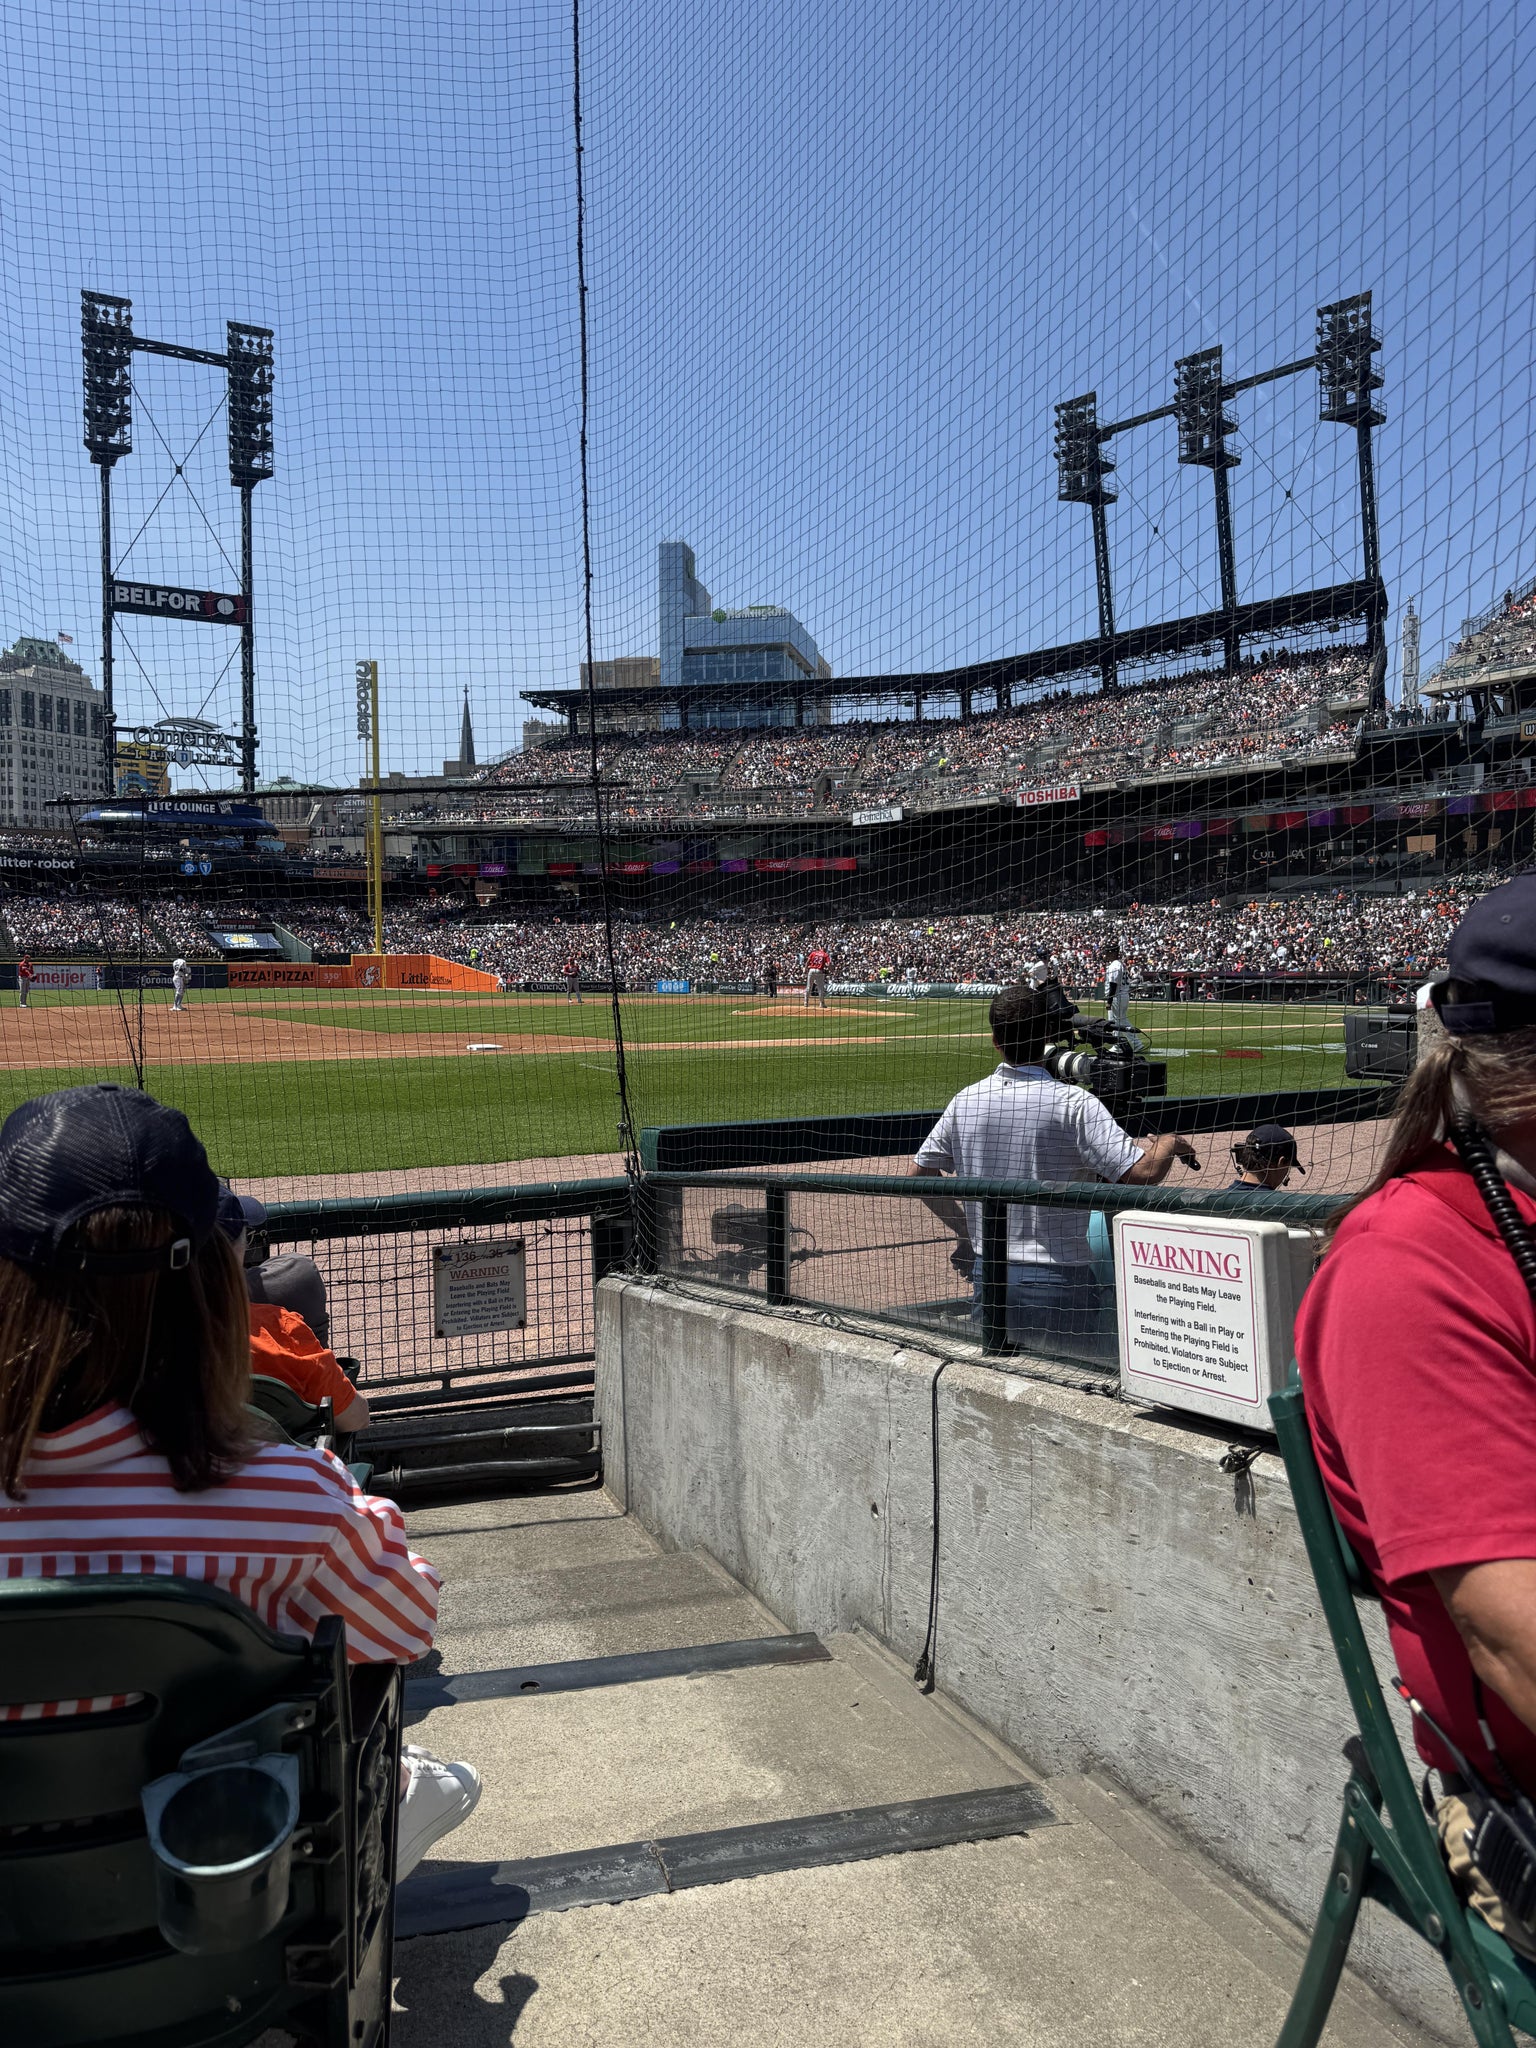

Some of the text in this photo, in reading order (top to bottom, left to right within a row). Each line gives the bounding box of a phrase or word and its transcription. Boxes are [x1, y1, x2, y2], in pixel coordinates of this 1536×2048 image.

[114, 585, 200, 612] BELFOR
[356, 678, 372, 740] Rocket
[135, 749, 234, 766] LANDING
[1018, 786, 1078, 804] TOSHIBA
[174, 802, 216, 814] LOUNGE
[1400, 804, 1430, 815] DOUBLE
[631, 823, 695, 832] TIGER CLUB
[36, 968, 86, 987] meijer
[137, 975, 172, 987] Corona
[230, 971, 314, 982] PIZZA! PIZZA!
[401, 972, 428, 984] Little
[1130, 1241, 1241, 1278] WARNING
[450, 1266, 508, 1279] WARNING
[1134, 1275, 1241, 1301] Baseballs and Bats May Leave
[1157, 1294, 1216, 1313] the Playing Field.
[1135, 1309, 1168, 1325] Interfering
[1171, 1318, 1185, 1327] with
[1194, 1321, 1207, 1332] Ball
[1210, 1324, 1216, 1334] in
[1218, 1326, 1234, 1339] Play
[1236, 1331, 1244, 1339] or
[1141, 1325, 1238, 1354] Entering the Playing Field is
[1134, 1338, 1248, 1372] Prohibited. Violators are Subject
[1154, 1358, 1160, 1366] to
[1162, 1360, 1190, 1374] Ejection
[1202, 1370, 1226, 1383] Arrest.
